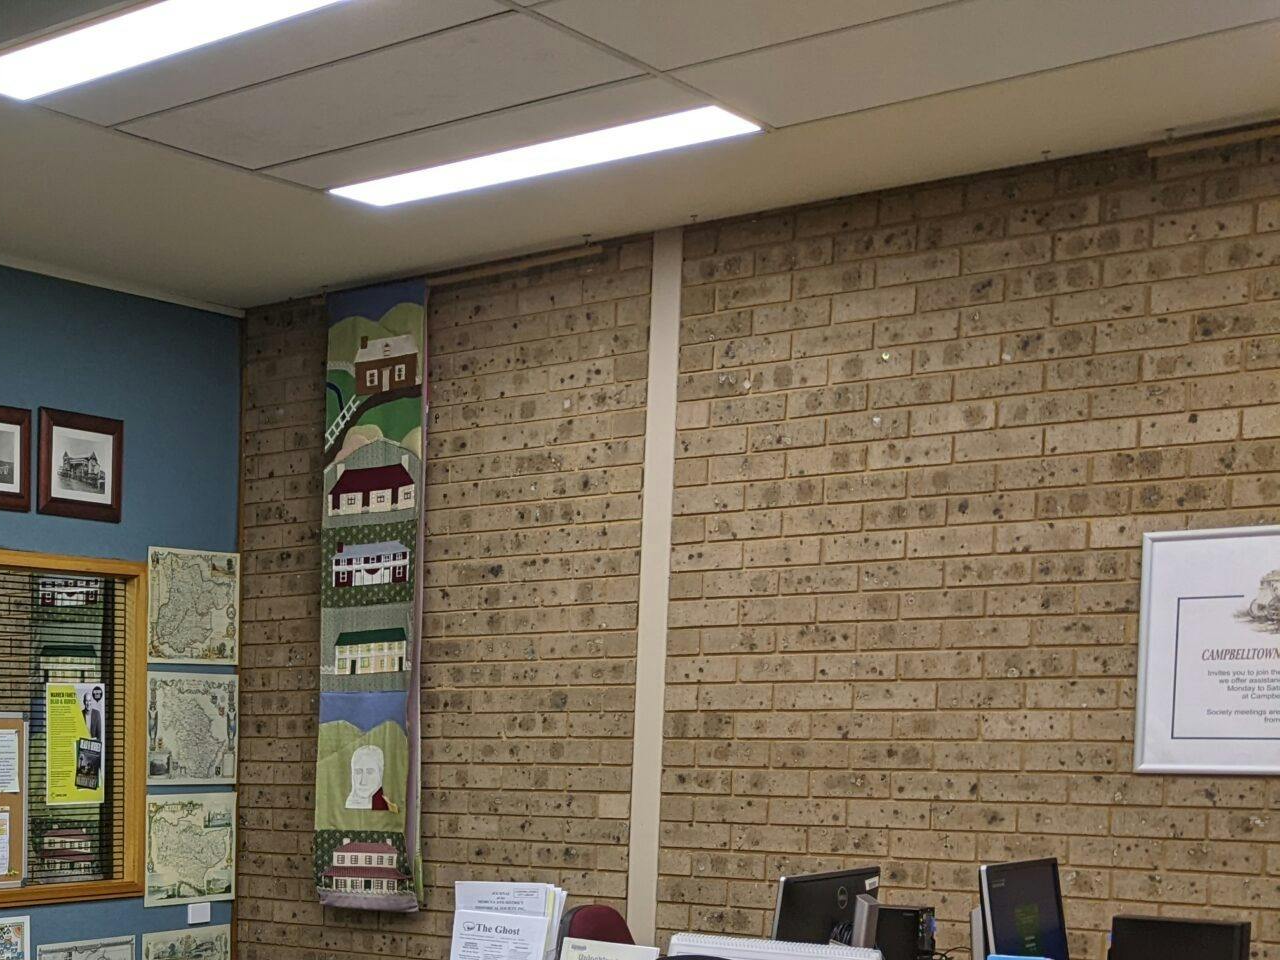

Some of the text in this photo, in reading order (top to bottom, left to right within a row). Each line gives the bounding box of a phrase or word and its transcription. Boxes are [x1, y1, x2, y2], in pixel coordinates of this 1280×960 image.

[1202, 648, 1280, 661] CAMPBELLTOWN
[1206, 708, 1232, 716] Society
[1234, 708, 1266, 716] meetings
[476, 924, 520, 936] The Ghost
